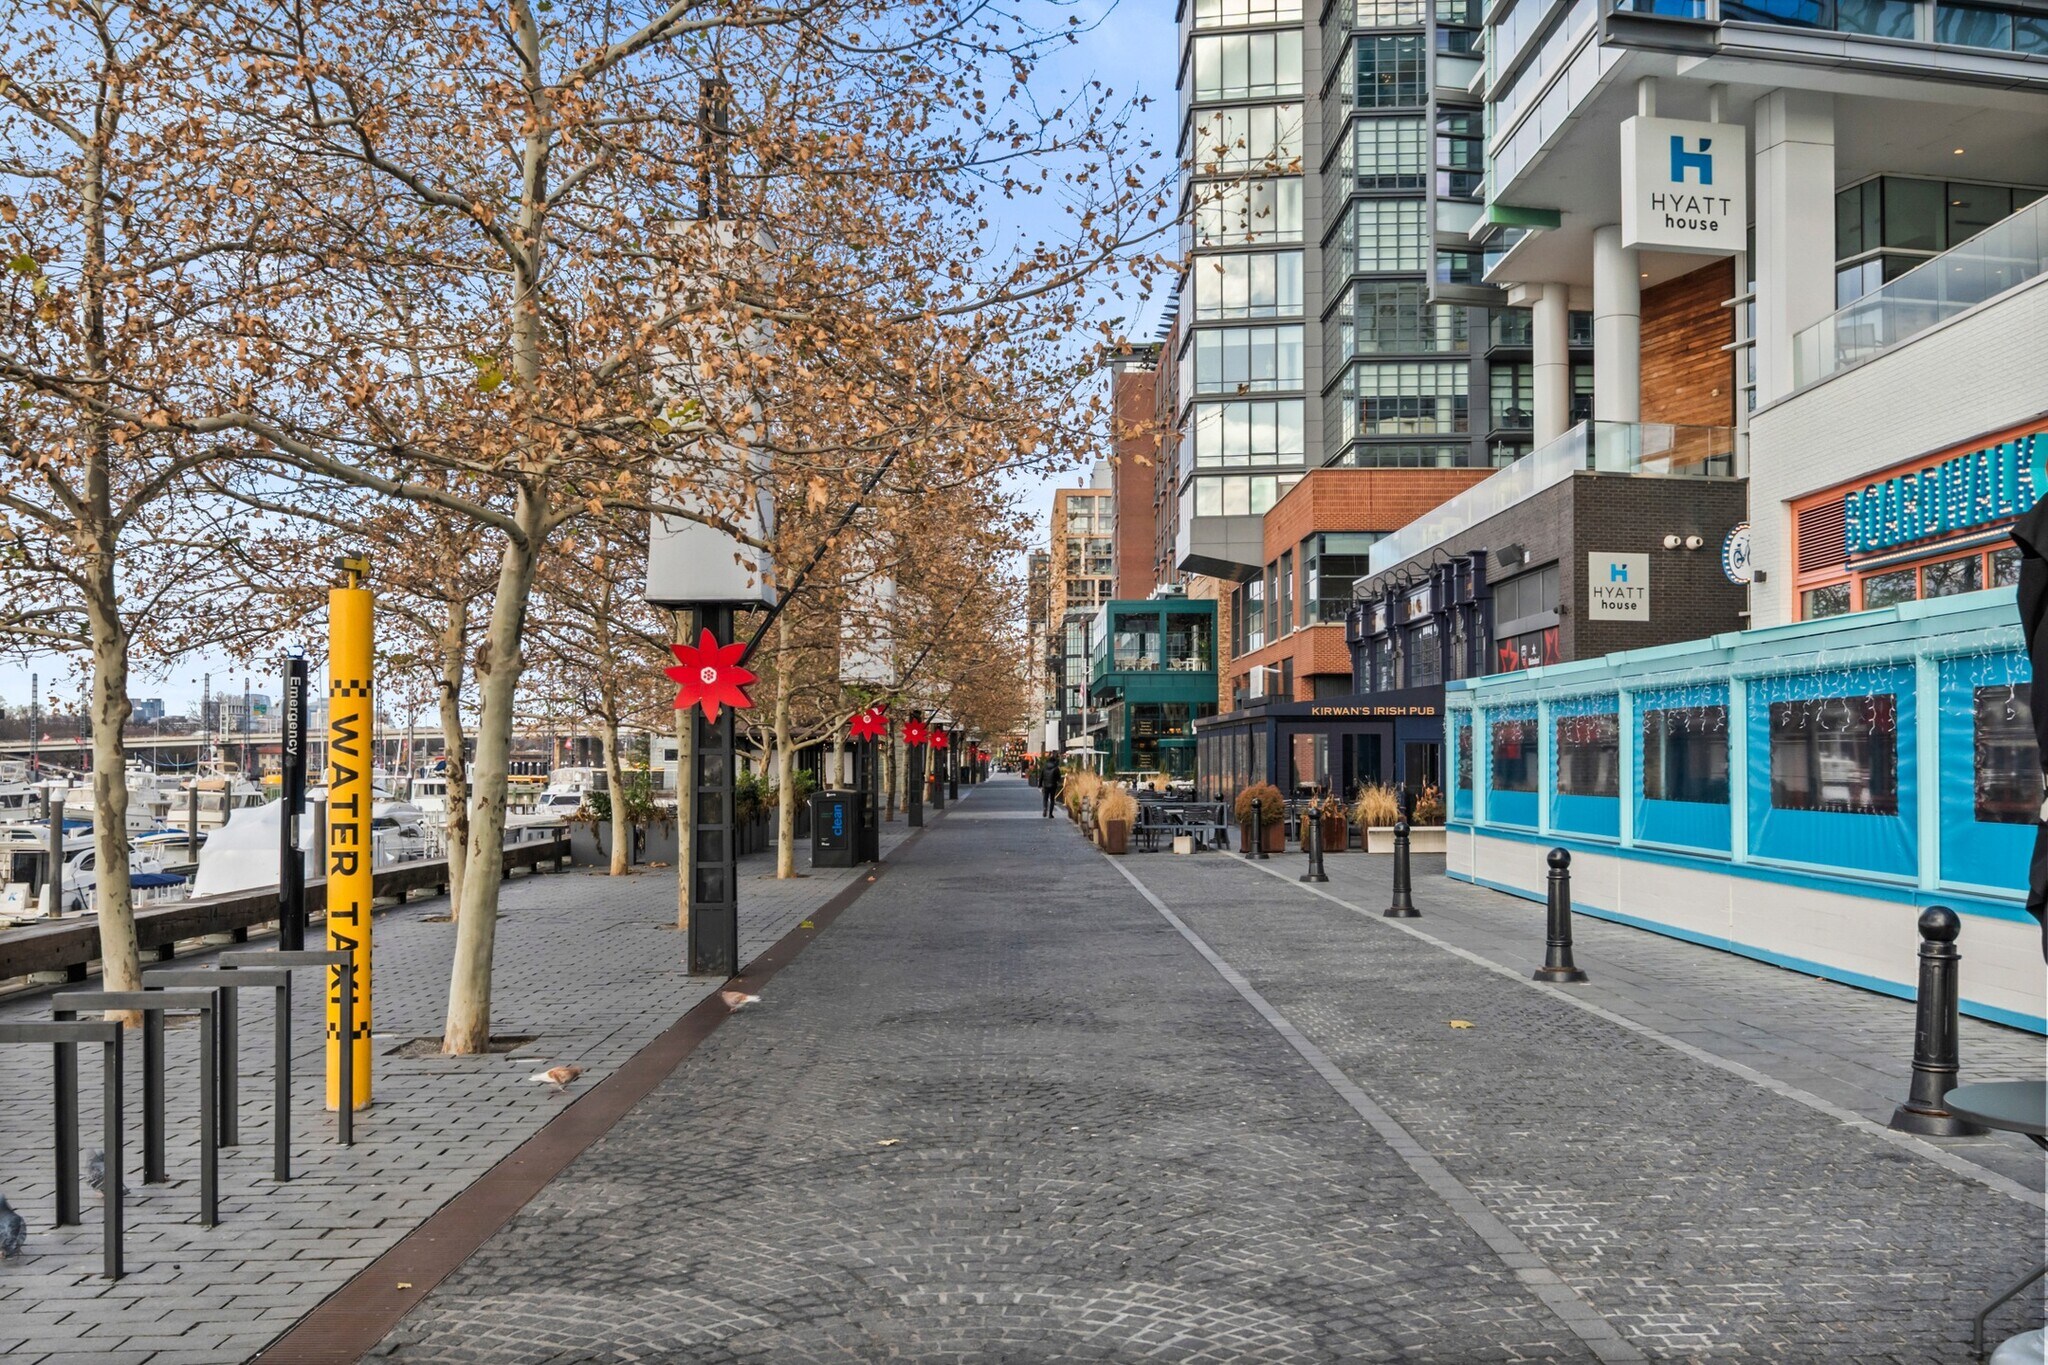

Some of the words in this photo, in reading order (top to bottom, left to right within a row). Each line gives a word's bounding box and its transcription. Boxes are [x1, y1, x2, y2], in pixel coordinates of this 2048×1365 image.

[1652, 192, 1731, 216] HYATT
[1665, 213, 1719, 231] house
[1845, 433, 2040, 555] BOARDWALK
[1593, 586, 1645, 599] HYATT
[1601, 599, 1637, 610] house
[286, 676, 301, 756] Emergency
[1311, 706, 1371, 716] KIRWAN'S
[1373, 706, 1406, 716] IRISH
[1409, 706, 1435, 716] PUB
[331, 713, 359, 876] WATER
[832, 804, 843, 836] clean
